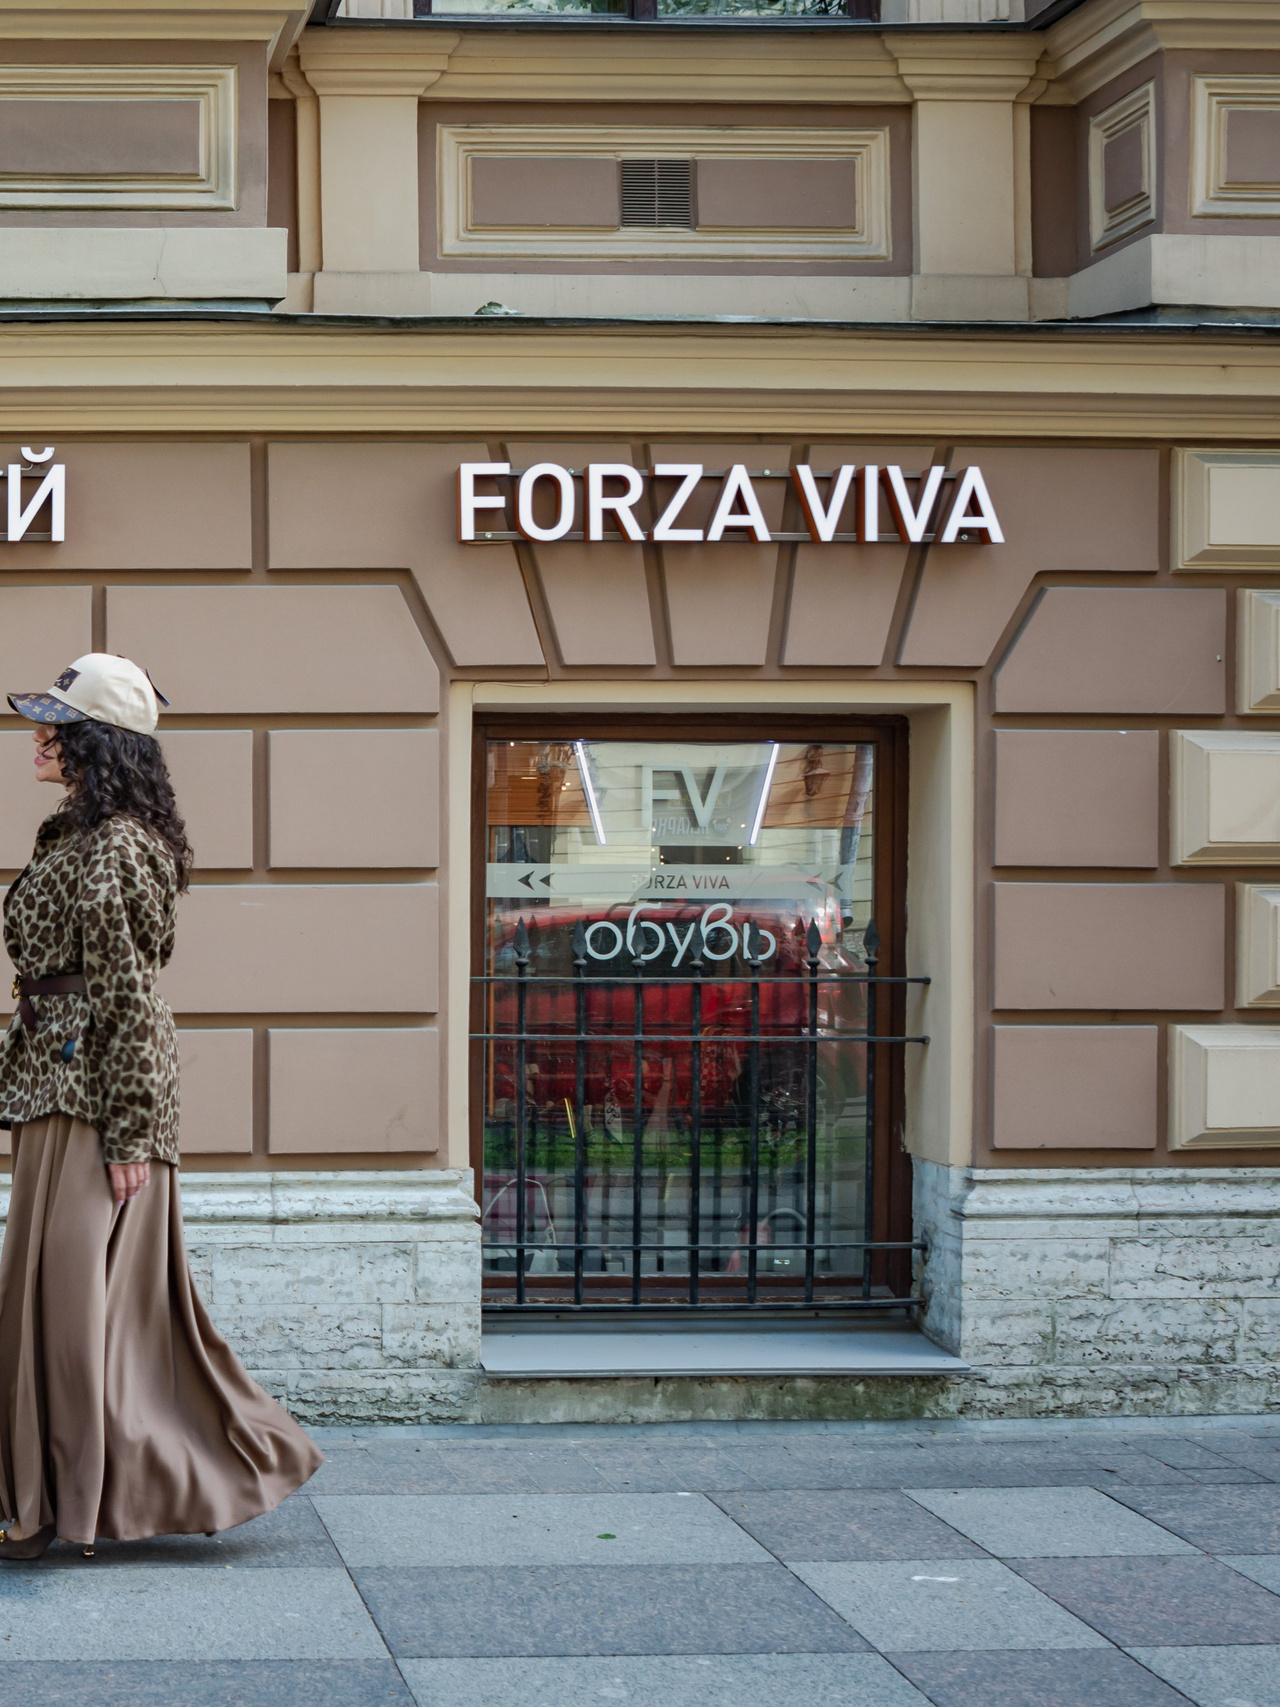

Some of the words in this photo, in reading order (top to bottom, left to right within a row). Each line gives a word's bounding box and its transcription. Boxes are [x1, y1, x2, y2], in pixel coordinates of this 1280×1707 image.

[459, 462, 771, 542] FORZA
[797, 464, 1005, 543] VIVA
[642, 761, 728, 829] FV
[692, 874, 730, 890] VIVA
[584, 902, 777, 968] обувь
